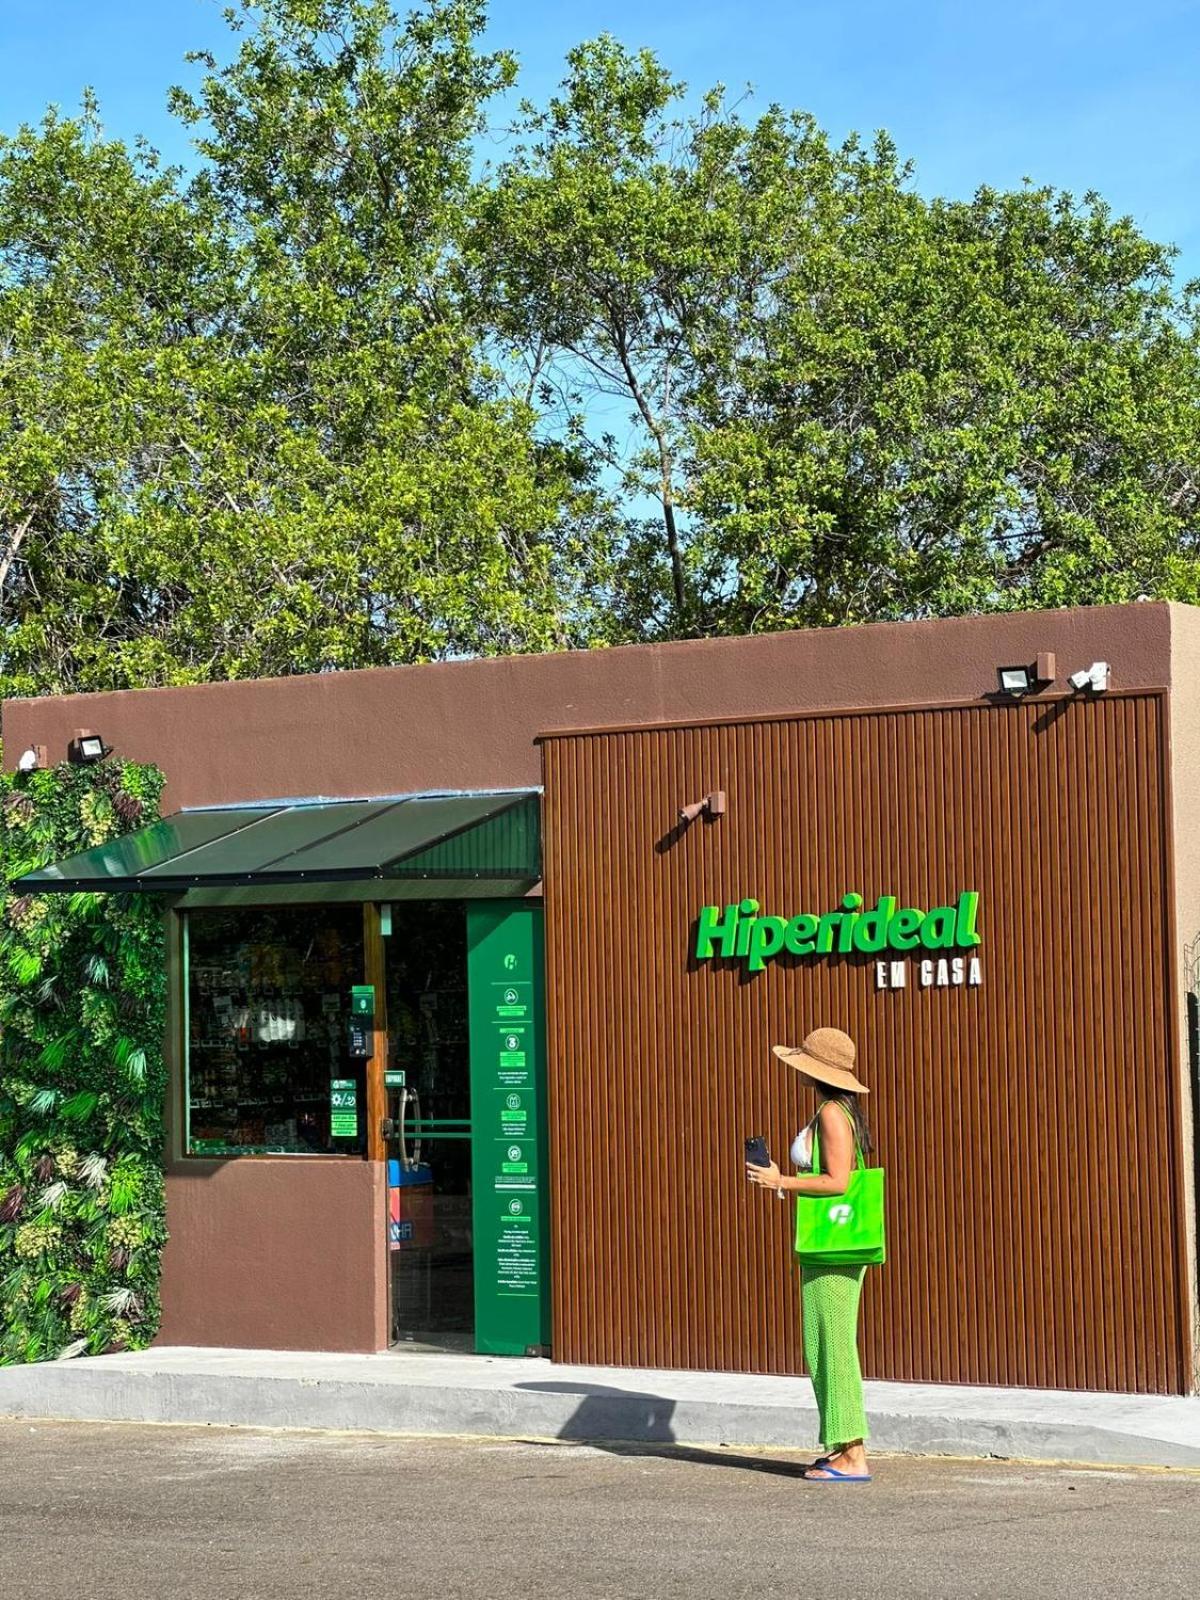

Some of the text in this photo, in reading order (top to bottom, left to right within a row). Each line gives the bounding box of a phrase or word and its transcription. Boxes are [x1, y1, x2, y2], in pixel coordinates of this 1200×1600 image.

[696, 891, 981, 971] Hiperideal
[876, 957, 982, 988] EM CASA
